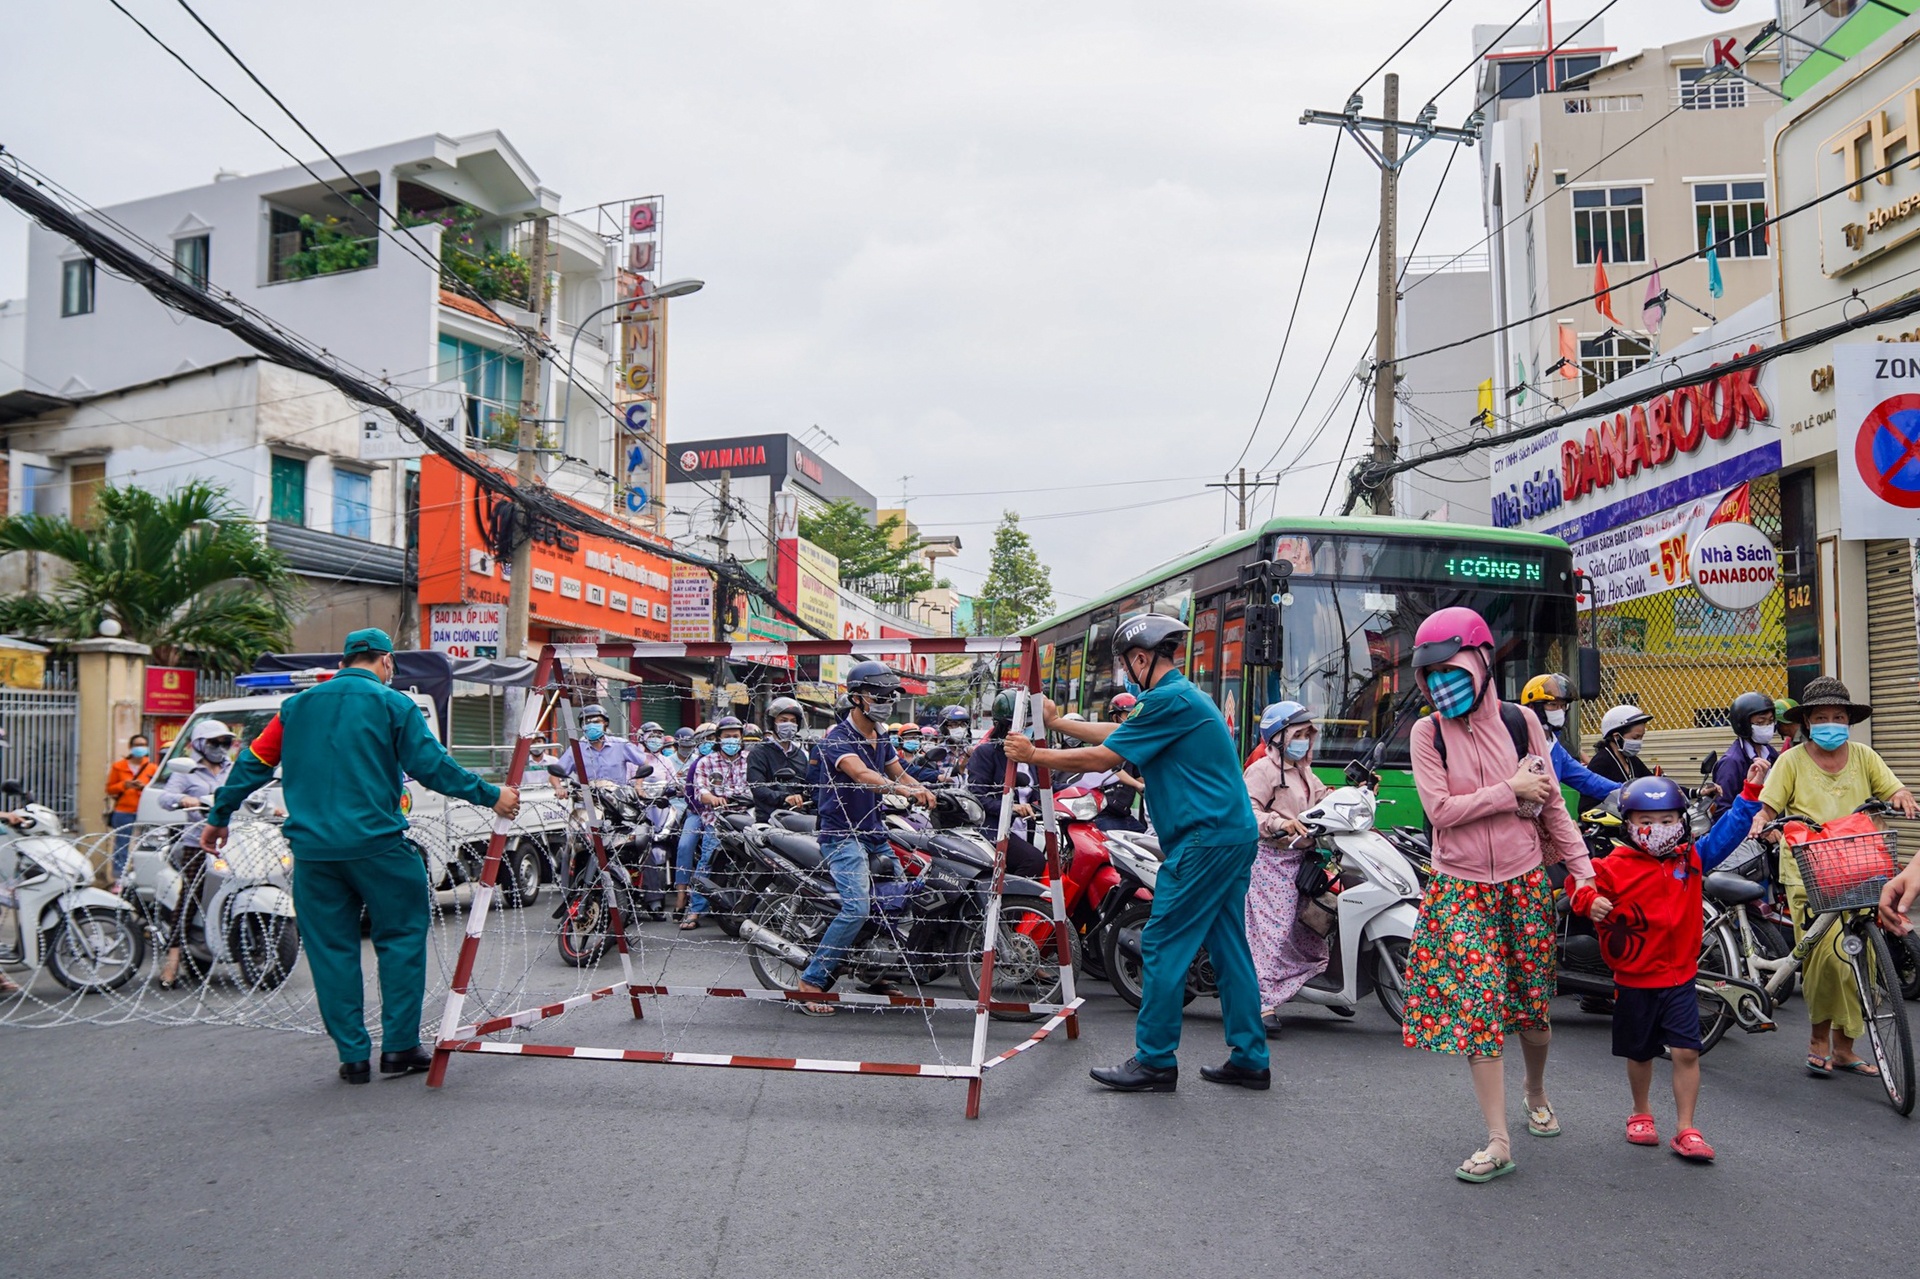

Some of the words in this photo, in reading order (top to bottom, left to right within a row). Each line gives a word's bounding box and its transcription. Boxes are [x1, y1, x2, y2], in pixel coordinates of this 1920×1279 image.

[1713, 37, 1740, 69] K
[1561, 344, 1768, 500] DANABOOK
[698, 445, 766, 469] YAMAHA
[1491, 483, 1522, 528] Nhà
[1522, 469, 1563, 520] Sách
[1628, 548, 1650, 568] Khoa
[1701, 545, 1732, 564] Nhà
[1736, 544, 1772, 562] Sách
[535, 573, 553, 587] SONY
[1626, 575, 1647, 597] Sinh
[1699, 566, 1775, 585] DANABOOK
[1788, 585, 1811, 609] 542
[434, 611, 450, 623] BAO
[433, 628, 451, 642] DÁN
